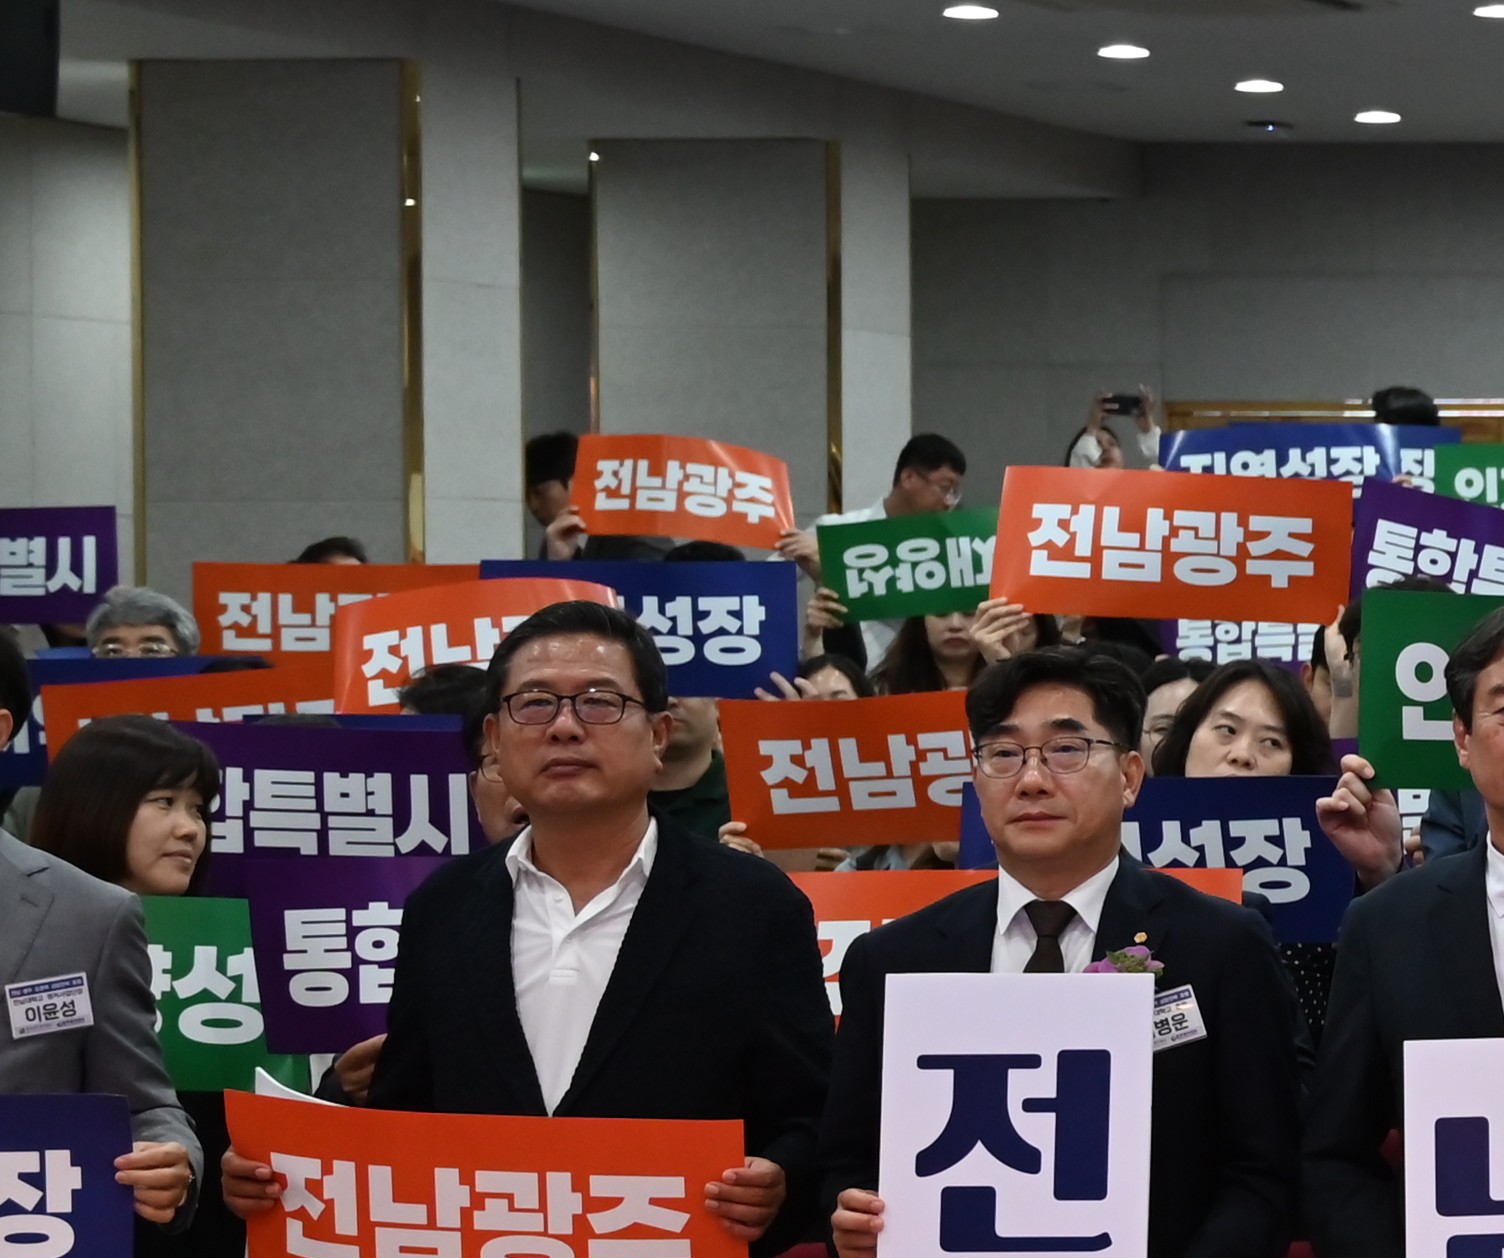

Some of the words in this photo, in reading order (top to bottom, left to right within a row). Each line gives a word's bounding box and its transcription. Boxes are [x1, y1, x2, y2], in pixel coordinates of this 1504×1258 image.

[594, 457, 777, 524] 전남광주
[1026, 503, 1314, 589] 전남광주
[217, 591, 391, 651] 전남
[628, 595, 765, 665] 성장
[362, 615, 530, 707] 전남
[210, 767, 469, 857] 합특별시
[25, 999, 77, 1022] 이윤성
[1153, 1012, 1189, 1037] 병운
[916, 1048, 1112, 1253] 전
